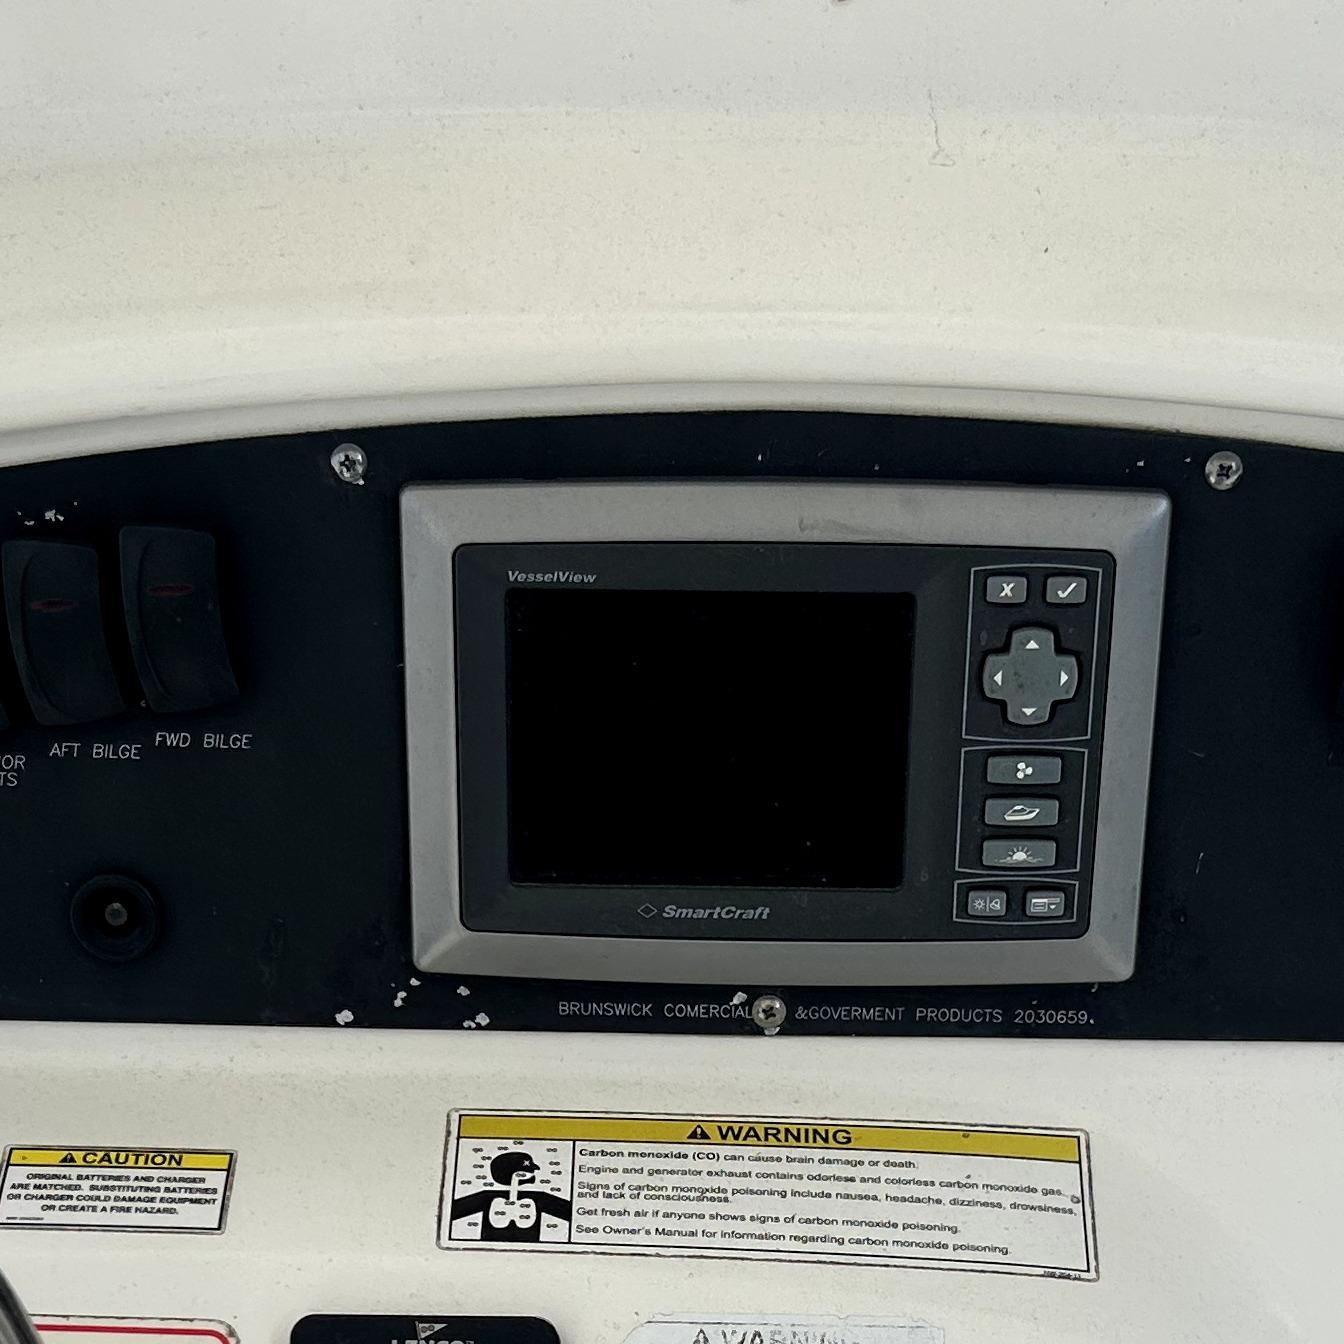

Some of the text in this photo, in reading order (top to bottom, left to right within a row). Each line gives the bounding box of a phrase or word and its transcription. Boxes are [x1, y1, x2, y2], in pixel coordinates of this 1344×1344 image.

[507, 570, 597, 584] VesselView
[155, 732, 252, 748] FWD BILGE
[49, 743, 141, 759] AFT BILGE
[662, 904, 770, 921] SmartCraft
[559, 1002, 651, 1016] BRUNSWICK
[664, 1003, 752, 1018] COMERCIAL
[916, 1008, 1001, 1022] PRODUCTS
[717, 1126, 851, 1144] WARNING
[82, 1152, 183, 1167] CAUTION
[579, 1148, 624, 1157] Carbon
[628, 1151, 688, 1159] monoxide
[692, 1151, 720, 1162] (CO)
[748, 1153, 782, 1162] cause
[786, 1155, 814, 1163] brain
[818, 1156, 864, 1167] damage
[883, 1159, 918, 1169] death.
[578, 1164, 618, 1174] Engine
[647, 1168, 702, 1176] generator
[755, 1172, 803, 1180] contains
[806, 1174, 856, 1182] odorless
[884, 1178, 935, 1186] colorless
[982, 1184, 1037, 1193] monoxide
[1041, 1188, 1065, 1197] gas.
[578, 1181, 612, 1192] Signs
[614, 1183, 625, 1191] of
[628, 1184, 669, 1193] carbon
[671, 1186, 728, 1196] monoxide
[731, 1188, 787, 1199] poisoning
[836, 1193, 880, 1201] nausea,
[885, 1195, 946, 1205] headache,
[949, 1199, 1006, 1209] dizziness,
[1010, 1202, 1077, 1215] drowsiness,
[576, 1207, 597, 1215] Get
[601, 1208, 630, 1216] fresh
[634, 1209, 648, 1217] air
[662, 1212, 705, 1220] anyone
[709, 1212, 746, 1221] shows
[749, 1214, 780, 1224] signs
[784, 1215, 794, 1223] of
[798, 1216, 838, 1225] carbon
[842, 1220, 898, 1229] monoxide
[902, 1223, 960, 1234] poisoning.
[576, 1224, 598, 1233] See
[602, 1225, 651, 1235] Owner's
[655, 1227, 697, 1236] Manual
[721, 1230, 785, 1240] information
[789, 1235, 844, 1245] regarding
[848, 1237, 888, 1246] carbon
[892, 1240, 948, 1249] monoxide
[953, 1244, 1011, 1255] poisoning.
